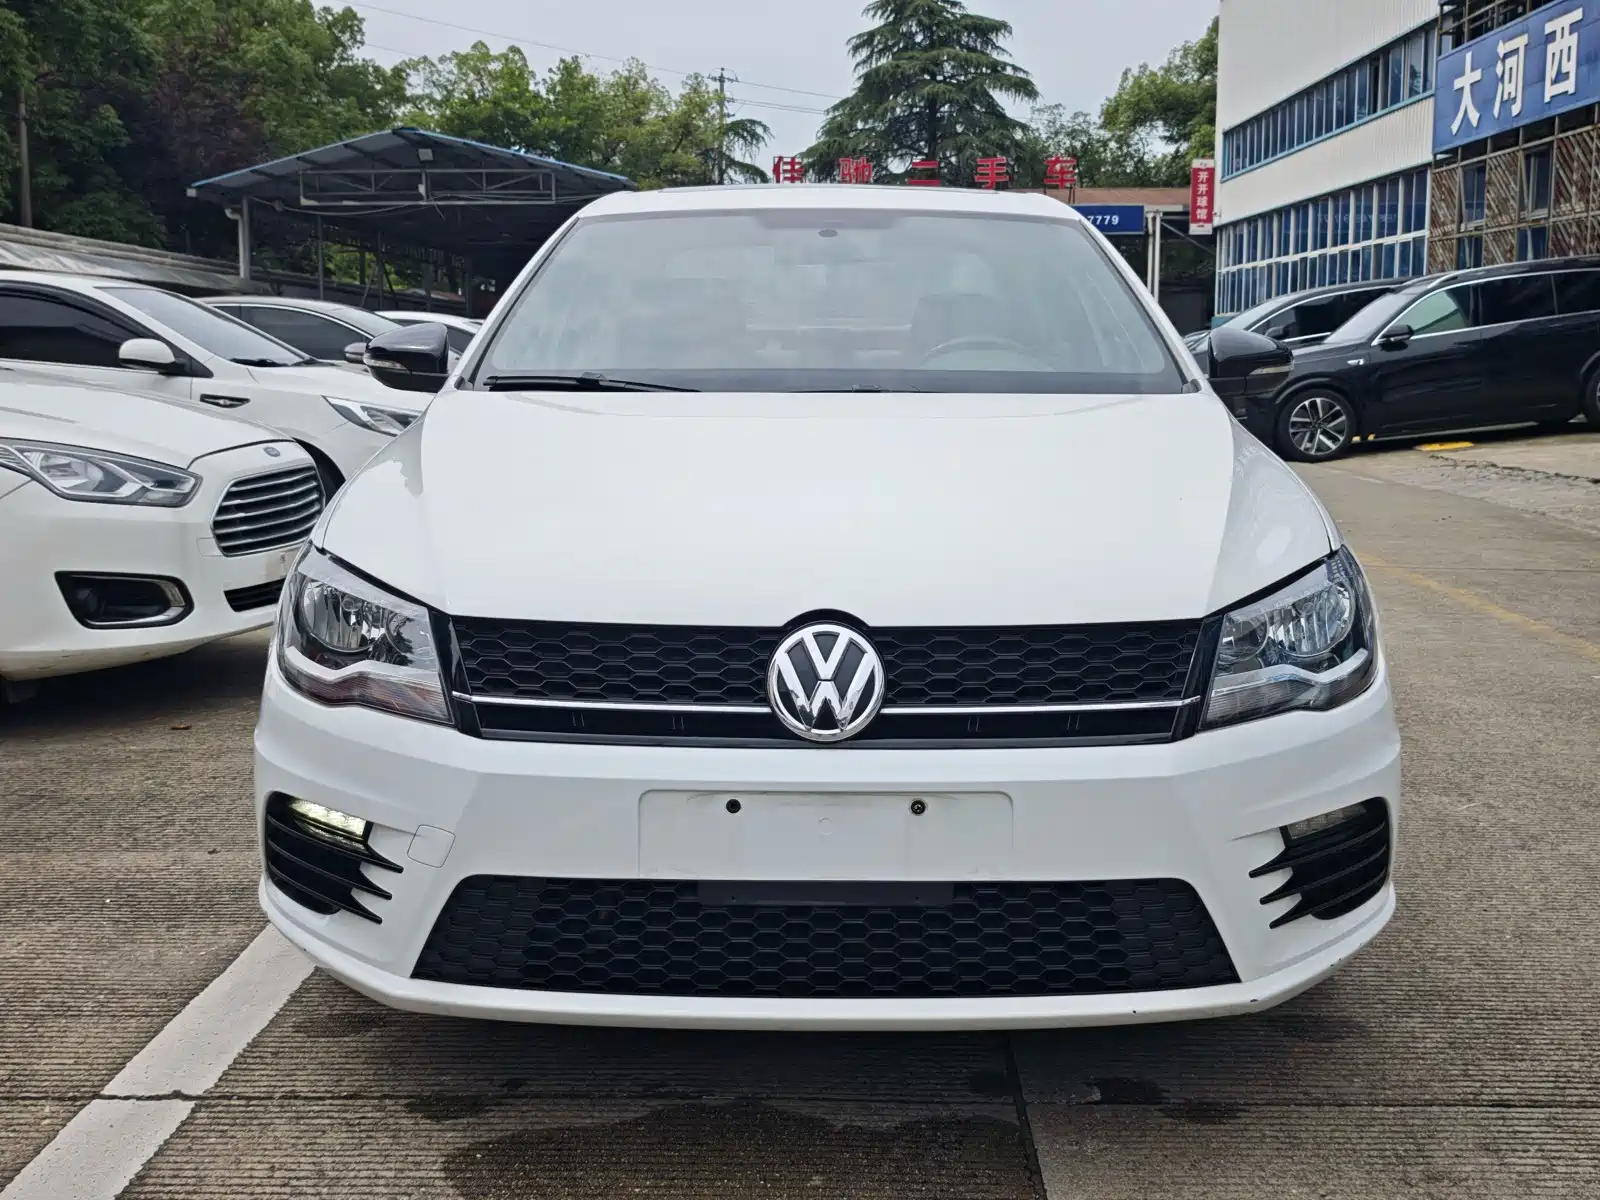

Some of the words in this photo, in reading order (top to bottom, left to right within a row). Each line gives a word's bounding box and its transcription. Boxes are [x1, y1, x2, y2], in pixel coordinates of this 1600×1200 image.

[1451, 7, 1583, 136] 大河西
[768, 624, 885, 742] VW
